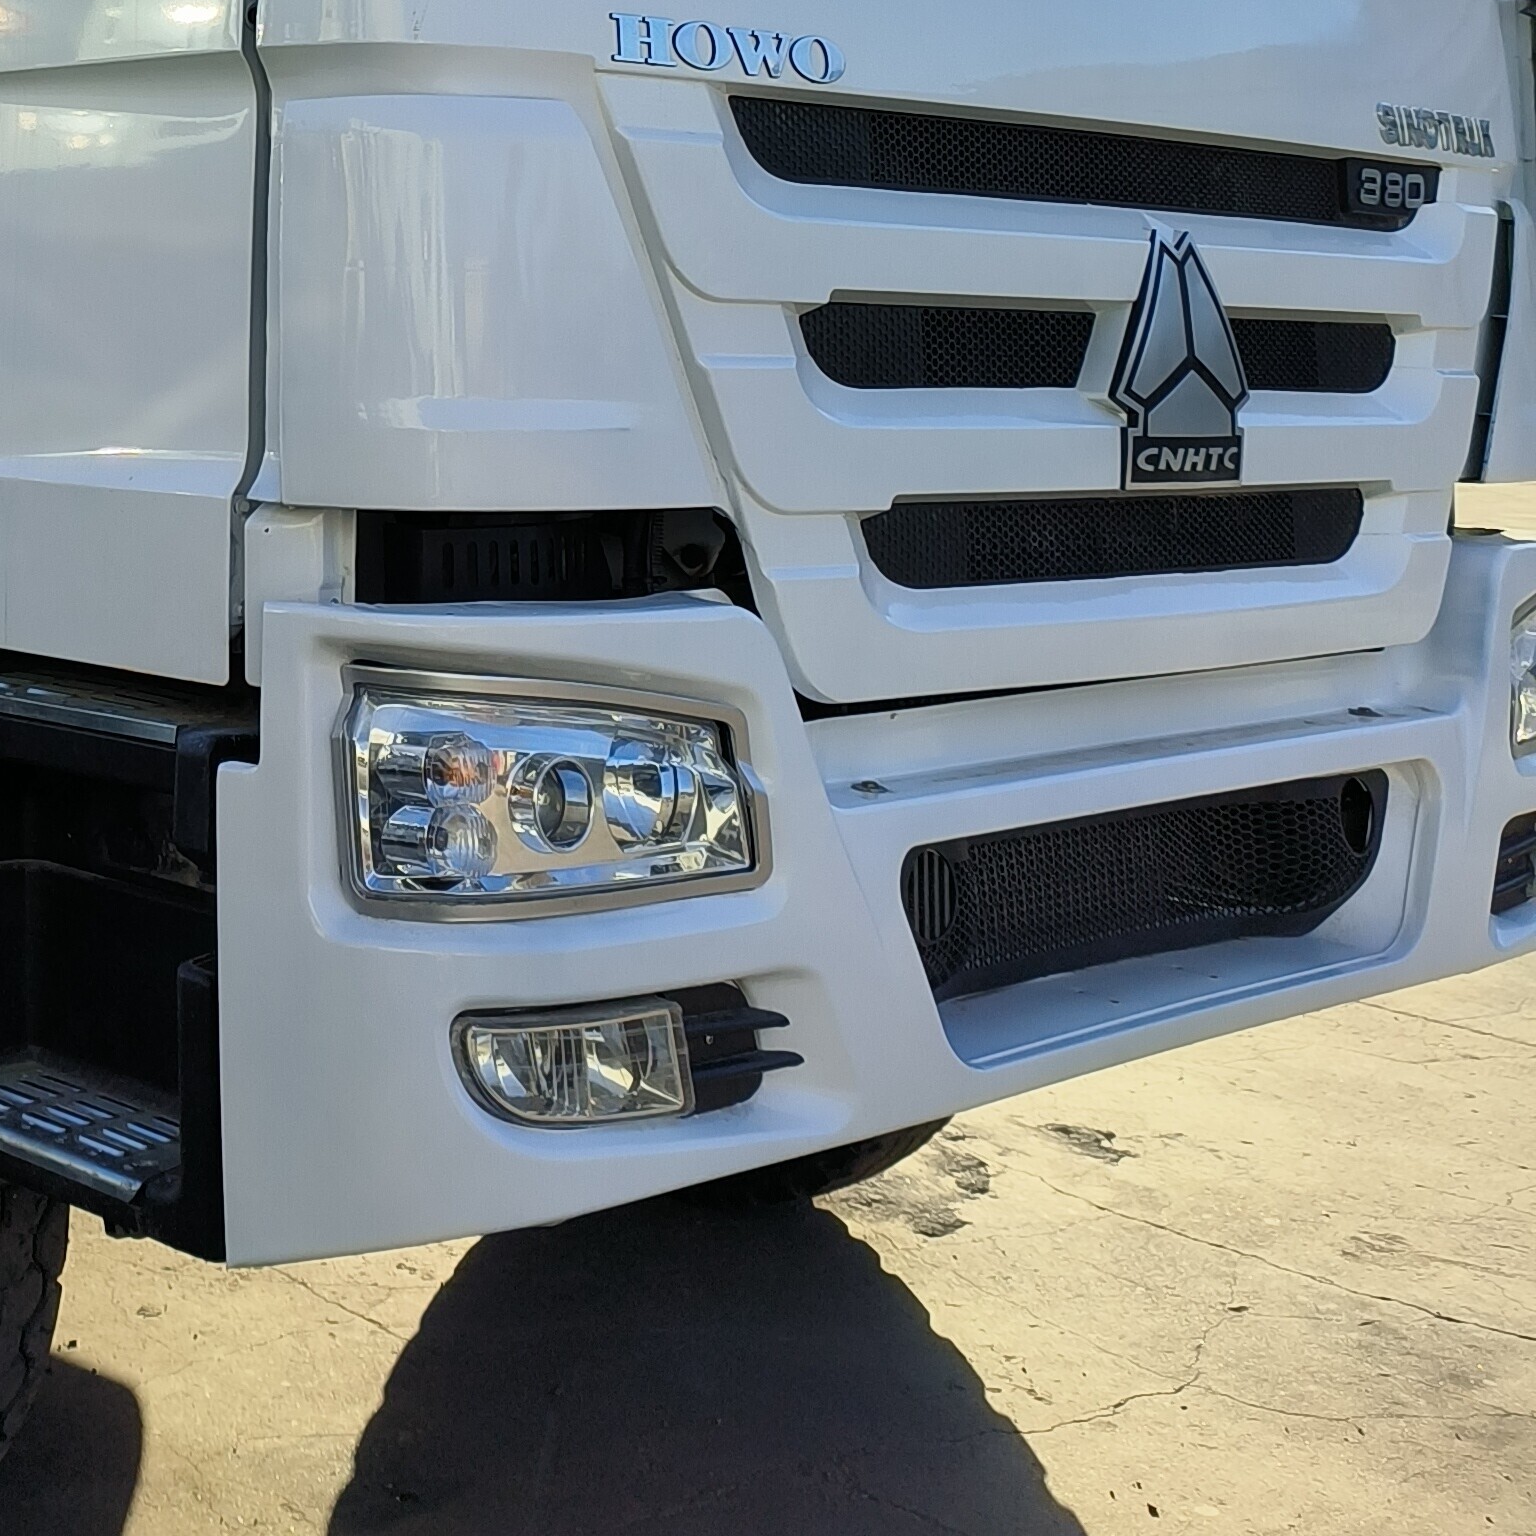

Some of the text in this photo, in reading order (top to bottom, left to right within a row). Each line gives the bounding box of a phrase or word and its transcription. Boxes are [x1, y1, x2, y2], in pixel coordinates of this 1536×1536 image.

[609, 12, 846, 84] HOWO
[1360, 168, 1425, 209] 380
[1136, 446, 1239, 472] CNHTC
